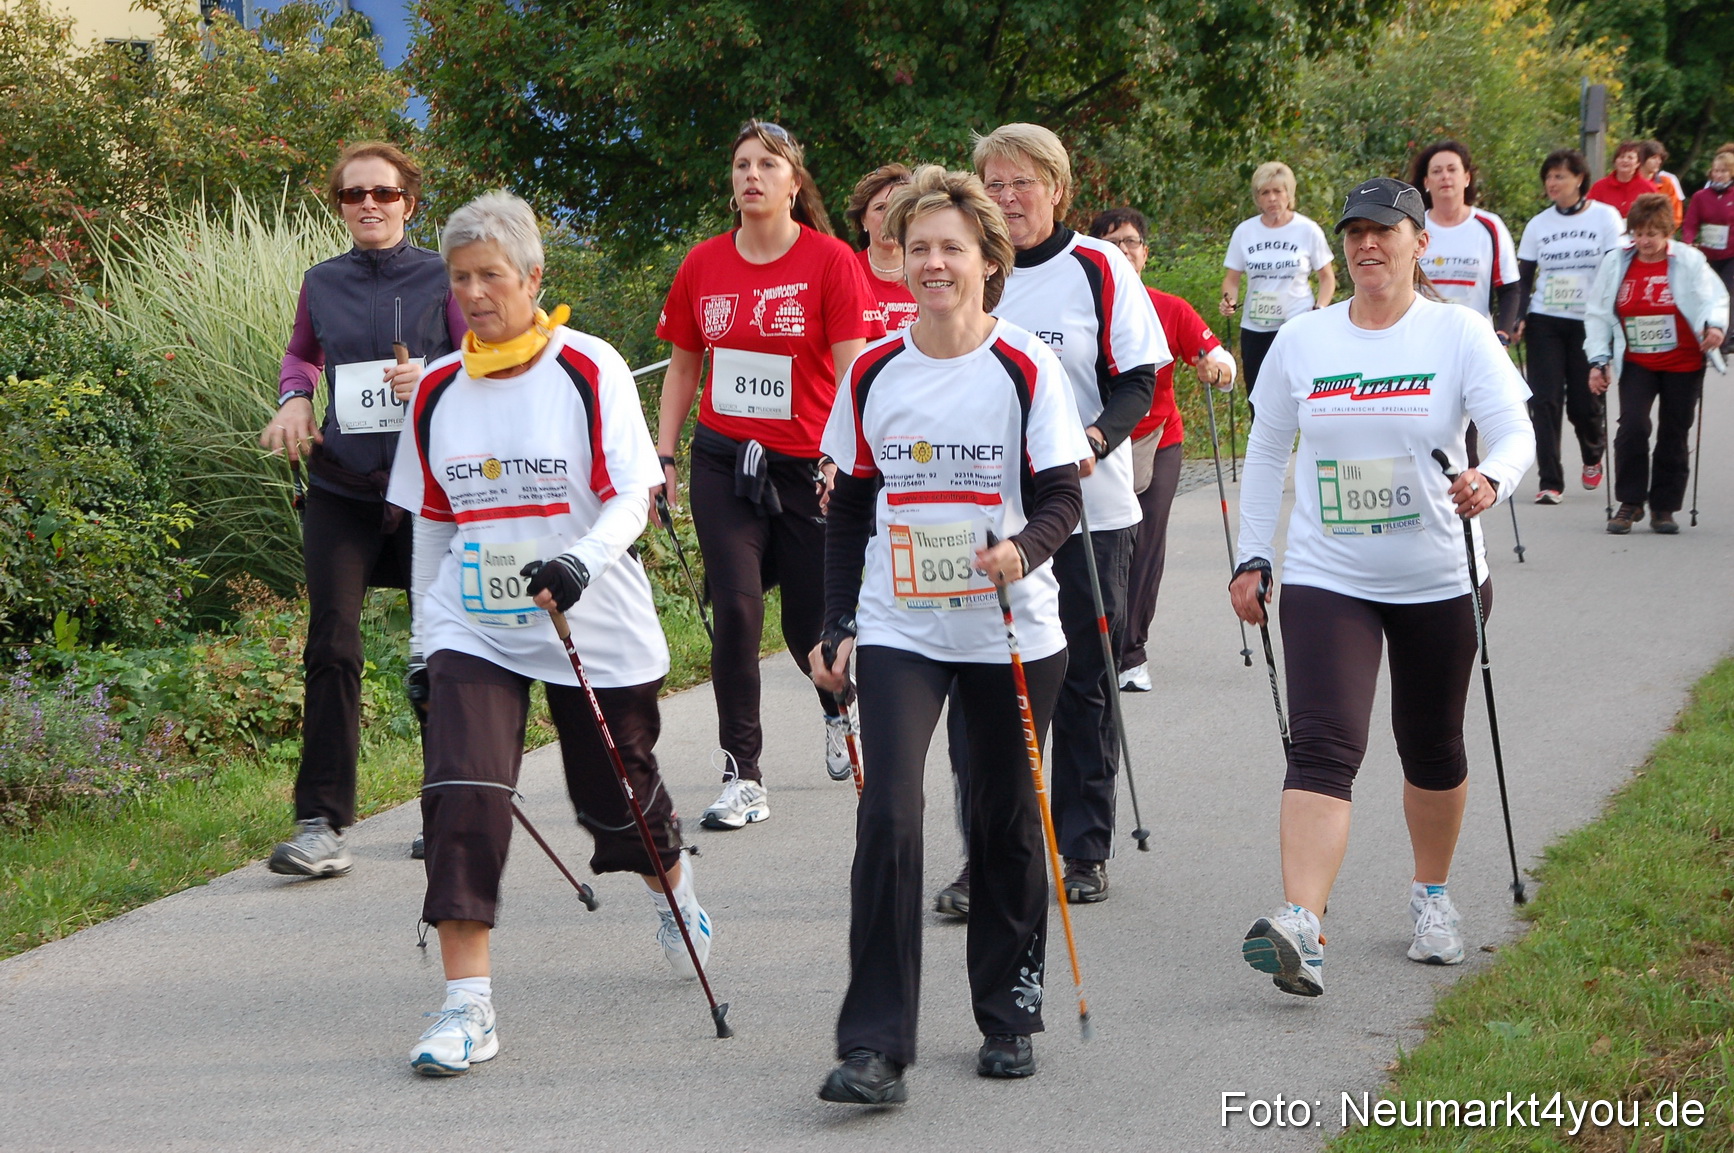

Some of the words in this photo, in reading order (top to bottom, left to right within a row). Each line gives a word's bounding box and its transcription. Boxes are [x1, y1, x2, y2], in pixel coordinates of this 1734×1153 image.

[1542, 230, 1597, 245] BERGER
[1247, 241, 1299, 254] BERGER
[1420, 256, 1480, 267] CHOTTNER
[1554, 288, 1583, 299] 8072
[1257, 304, 1283, 316] 8058
[705, 315, 728, 327] NEU
[1640, 328, 1673, 341] 8065
[735, 376, 785, 398] 8106
[1358, 376, 1430, 397] ITALIA
[361, 387, 403, 408] 810
[1342, 465, 1362, 480] Ulli
[1347, 485, 1412, 511] 8096
[914, 529, 977, 548] Theresia
[578, 665, 605, 722] NORDIC
